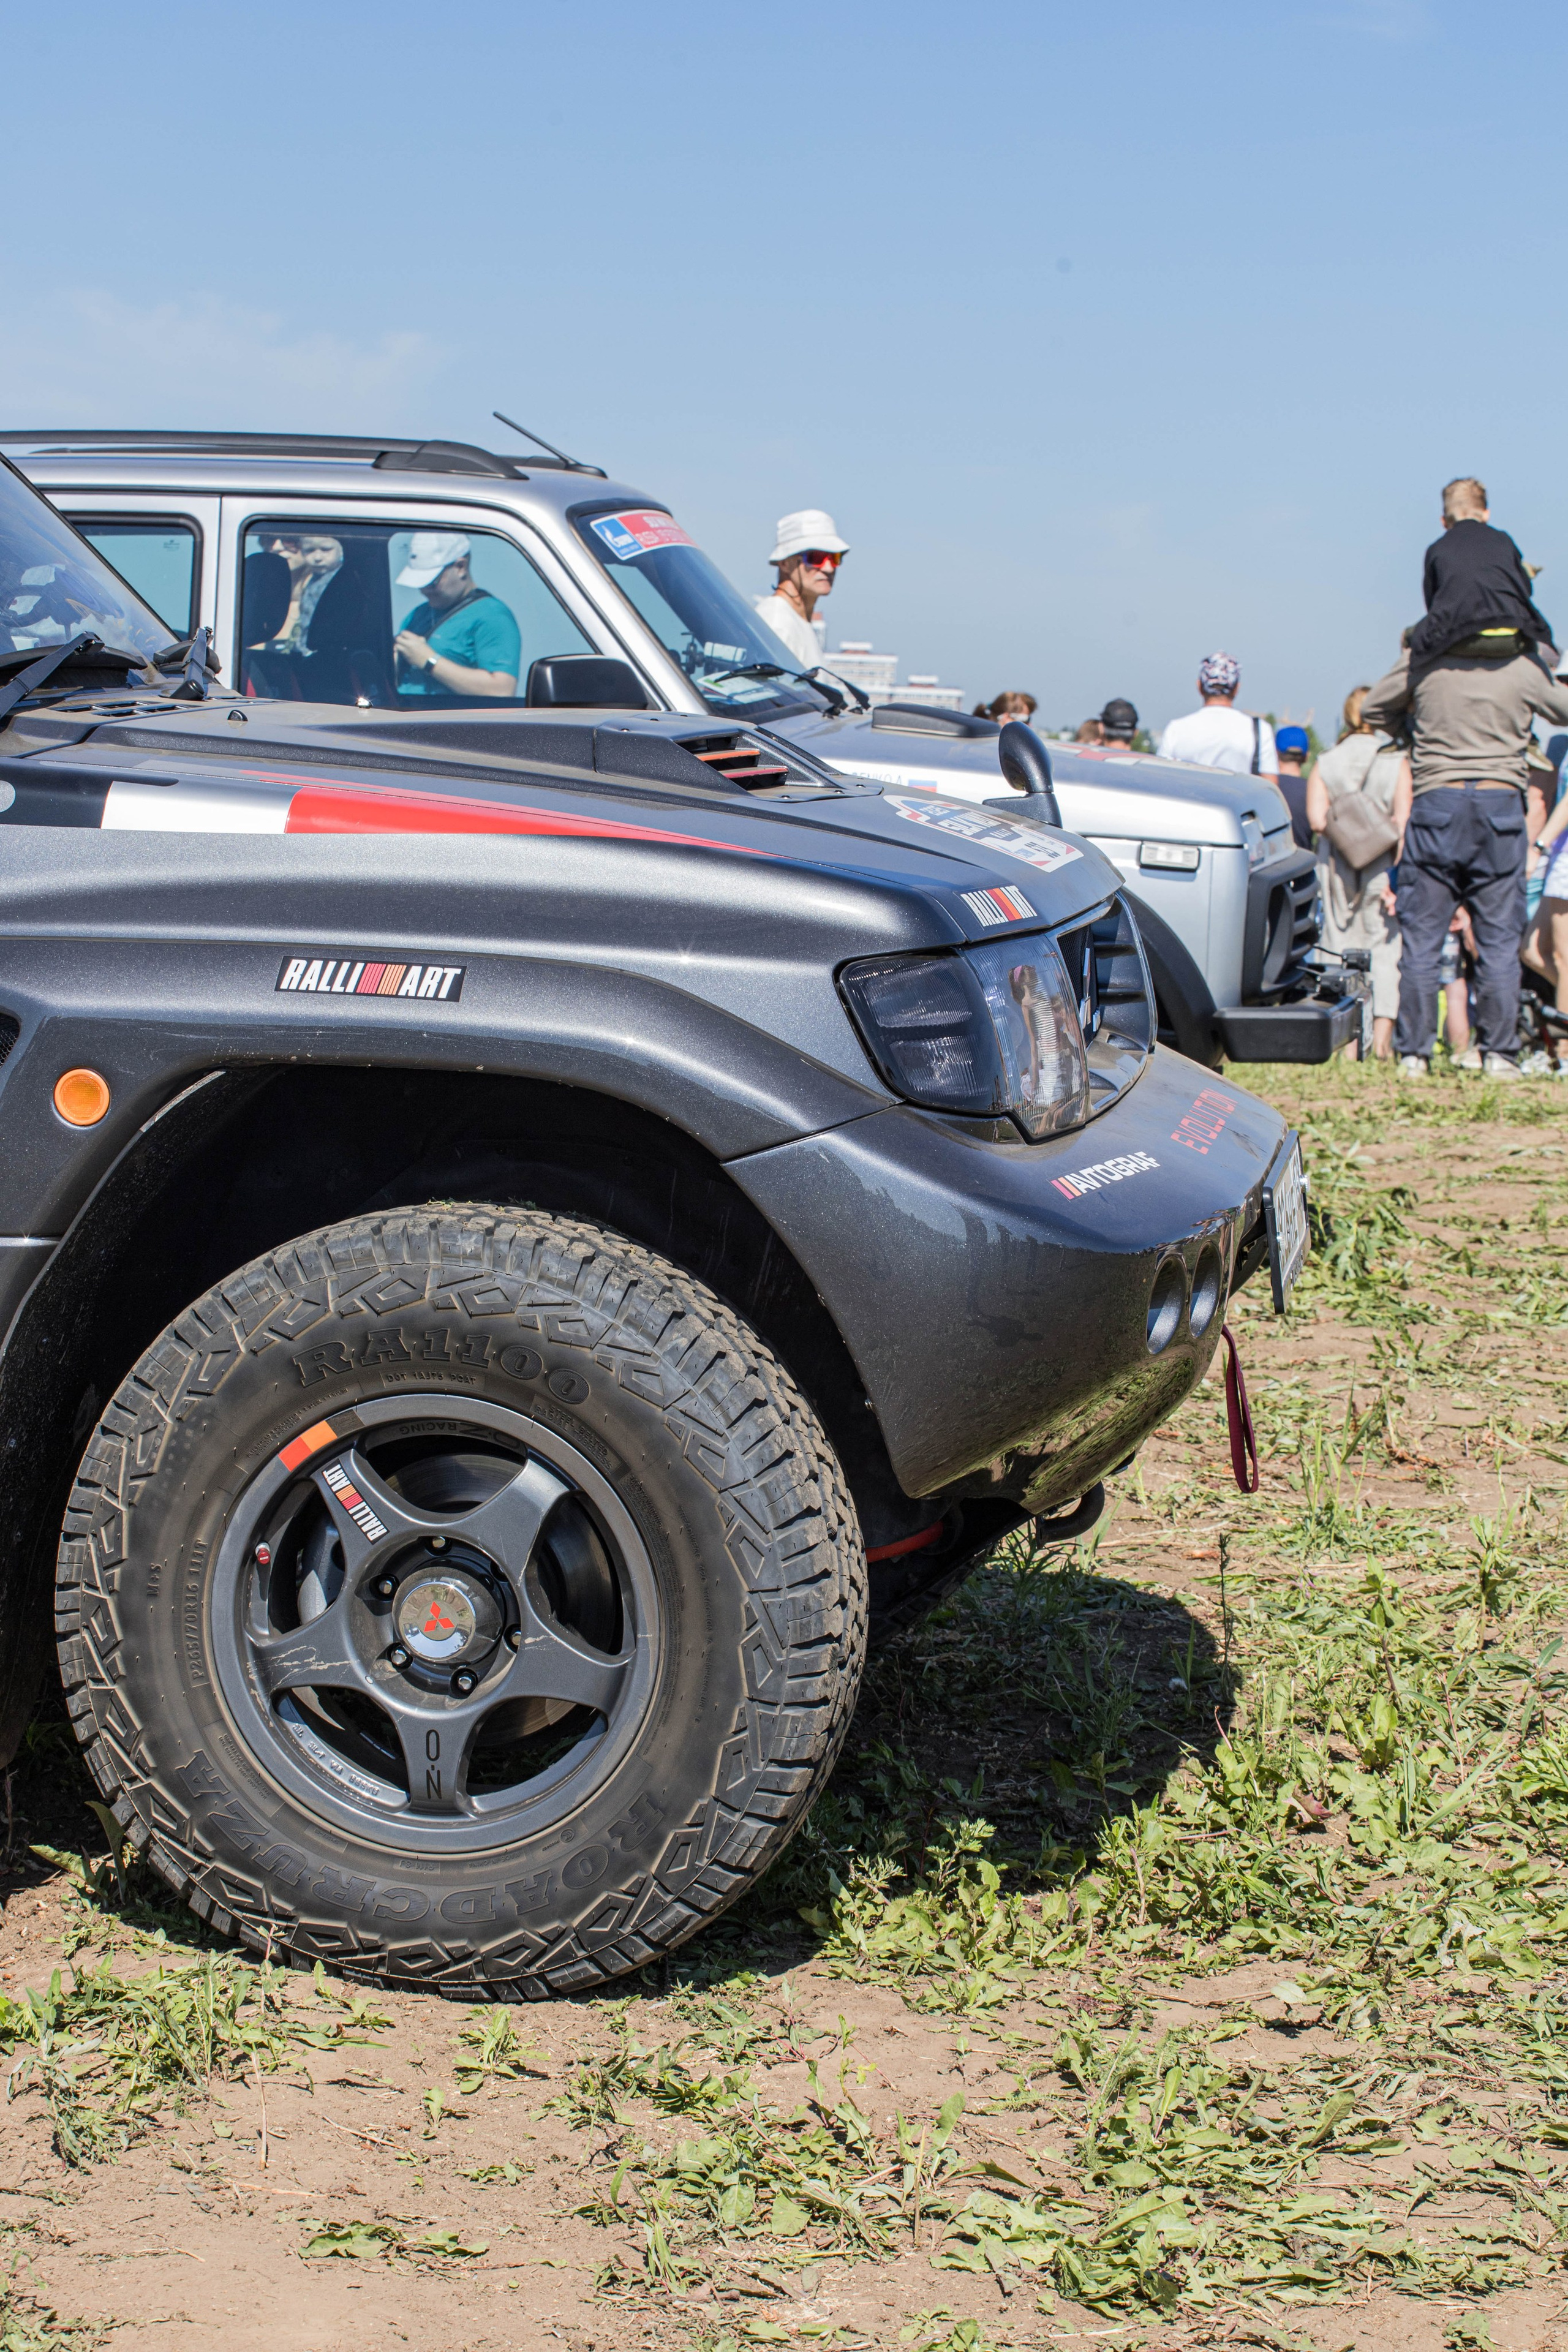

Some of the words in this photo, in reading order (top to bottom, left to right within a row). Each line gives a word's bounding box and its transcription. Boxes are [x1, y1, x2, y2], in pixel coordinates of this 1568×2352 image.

[960, 885, 1038, 927] RALLIART
[280, 959, 462, 998] RALLIART
[1170, 1087, 1238, 1155] EVOLUTION
[1064, 1151, 1161, 1194] AVTOGRAF
[292, 1327, 591, 1404] RA1100
[386, 1371, 406, 1382] DOT
[399, 1422, 456, 1434] RACING
[547, 1404, 577, 1427] STEEL
[578, 1425, 611, 1456] BELTED
[570, 1429, 614, 1470] TUBELESS
[322, 1464, 388, 1541] RALLIART
[186, 1538, 209, 1576] 111T
[146, 1562, 163, 1597] M+S
[184, 1582, 205, 1680] P265/70R16
[175, 1749, 665, 1924] ROADCRUZA
